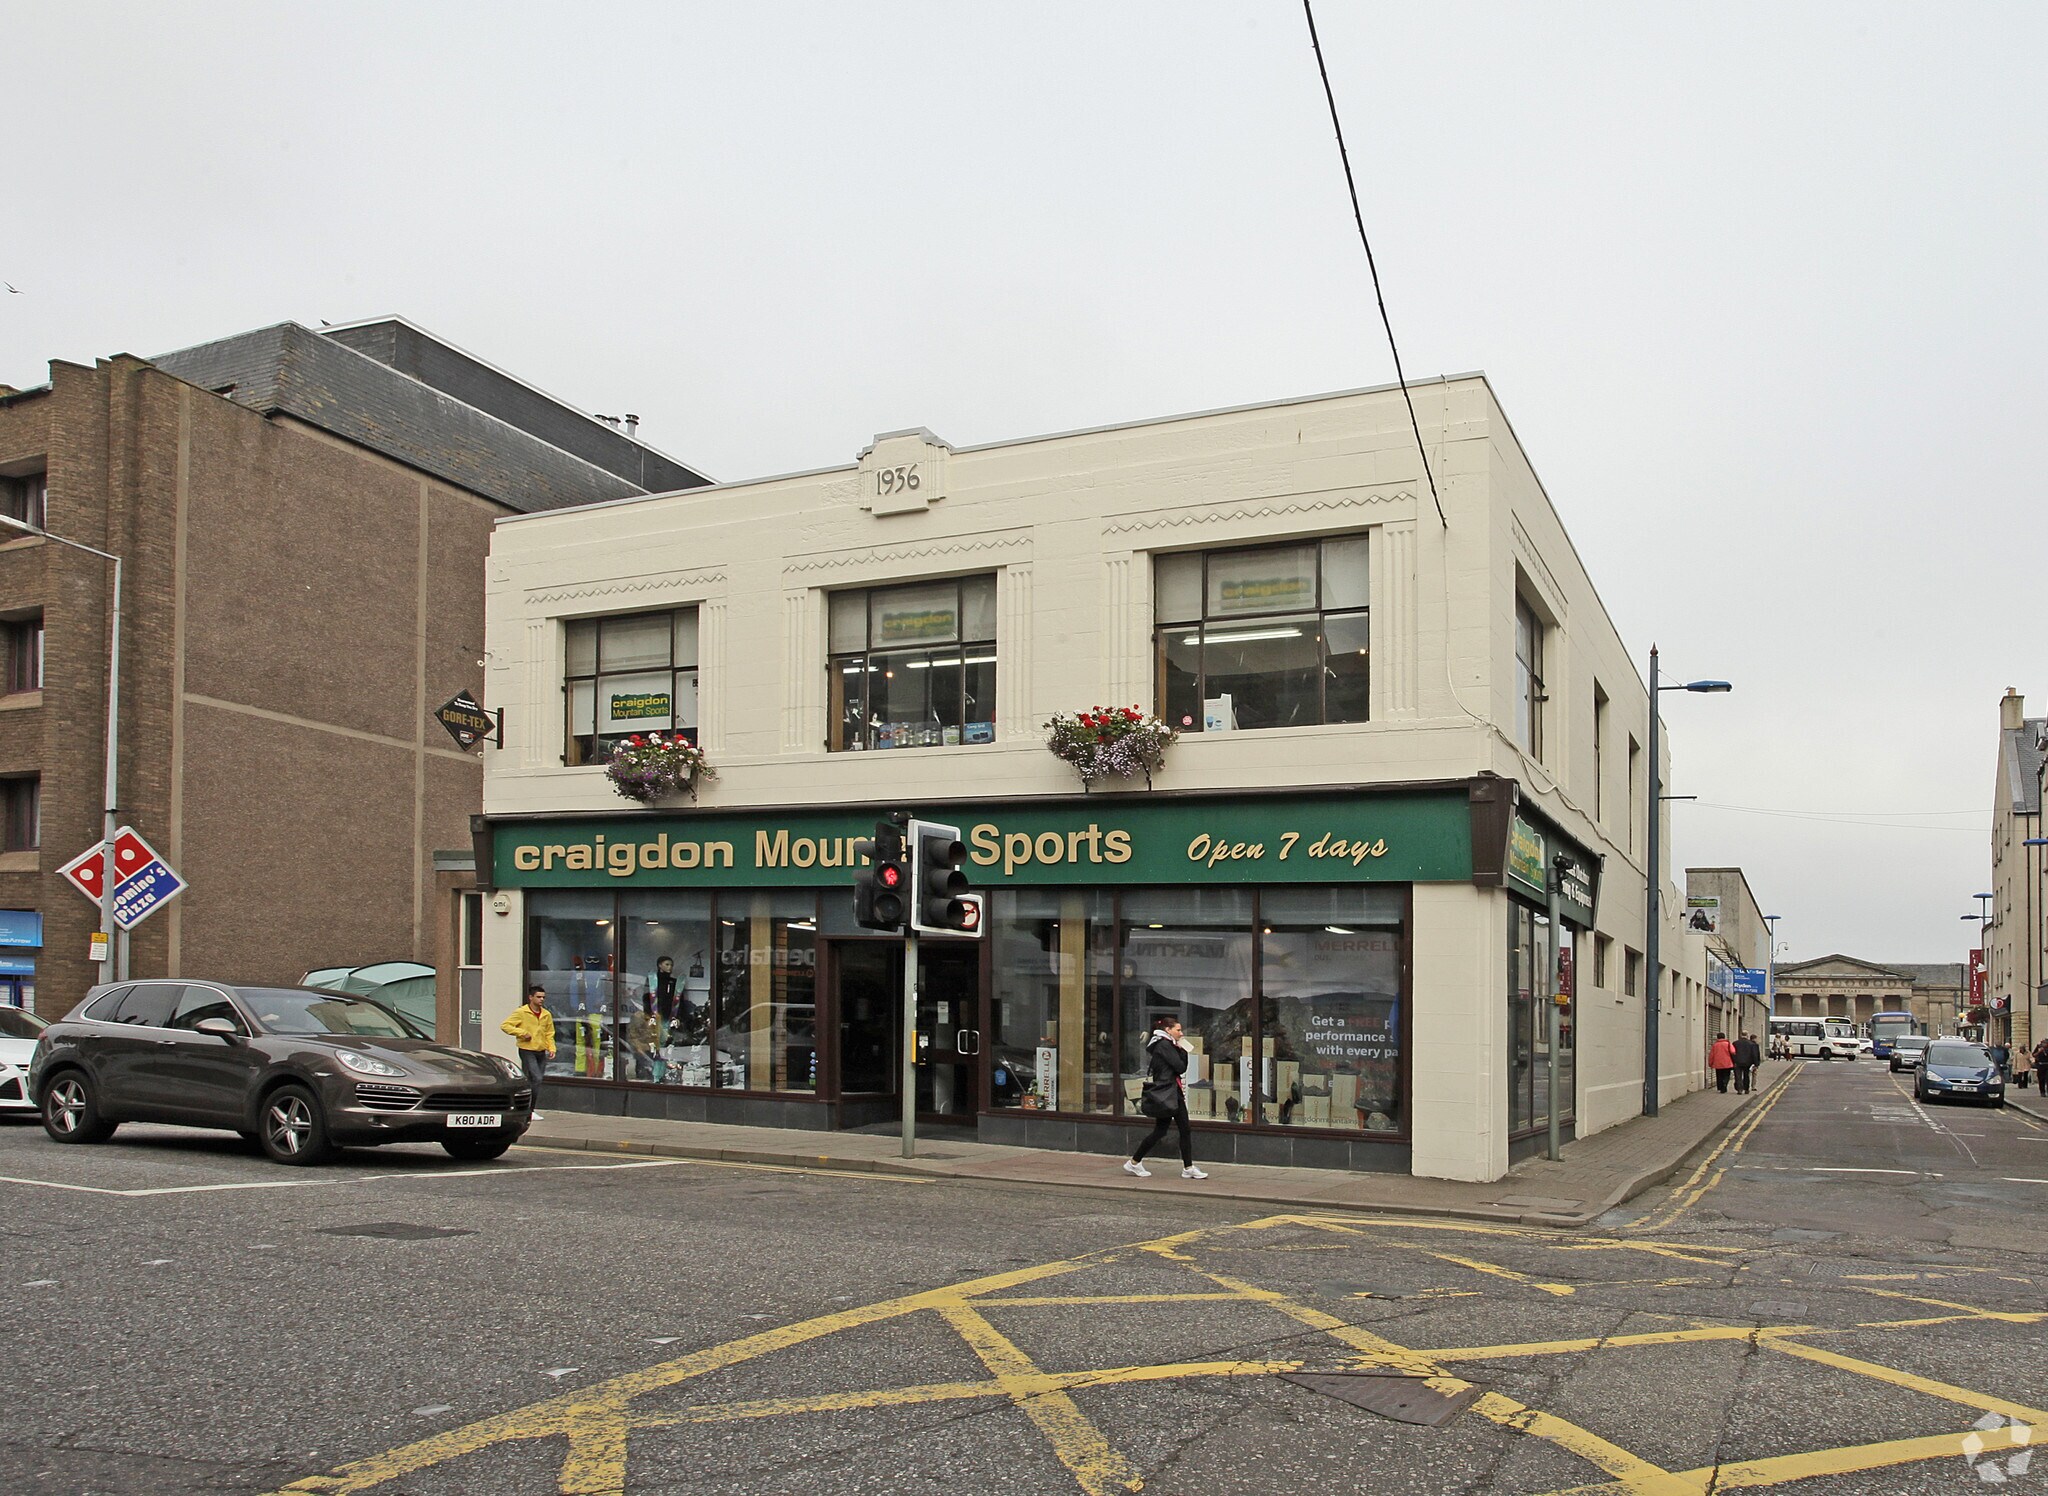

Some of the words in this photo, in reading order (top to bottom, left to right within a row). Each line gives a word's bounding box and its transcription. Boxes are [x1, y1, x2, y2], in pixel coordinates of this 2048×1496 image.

[876, 463, 920, 495] 1936
[612, 696, 668, 708] craigdon
[612, 708, 644, 718] Mountain
[645, 706, 669, 716] Sports
[442, 709, 486, 730] GORE-TEX
[513, 833, 734, 878] craigdon
[969, 822, 1133, 876] Sports
[1187, 832, 1266, 869] Open
[1278, 831, 1300, 861] 7
[1307, 831, 1389, 867] days
[115, 891, 157, 923] Pizza
[1311, 1015, 1334, 1027] Get
[1337, 1018, 1345, 1027] a
[1305, 1031, 1386, 1042] performance
[1316, 1045, 1343, 1055] with
[1346, 1047, 1381, 1059] every
[455, 1115, 475, 1126] K80
[476, 1115, 495, 1126] ADR
